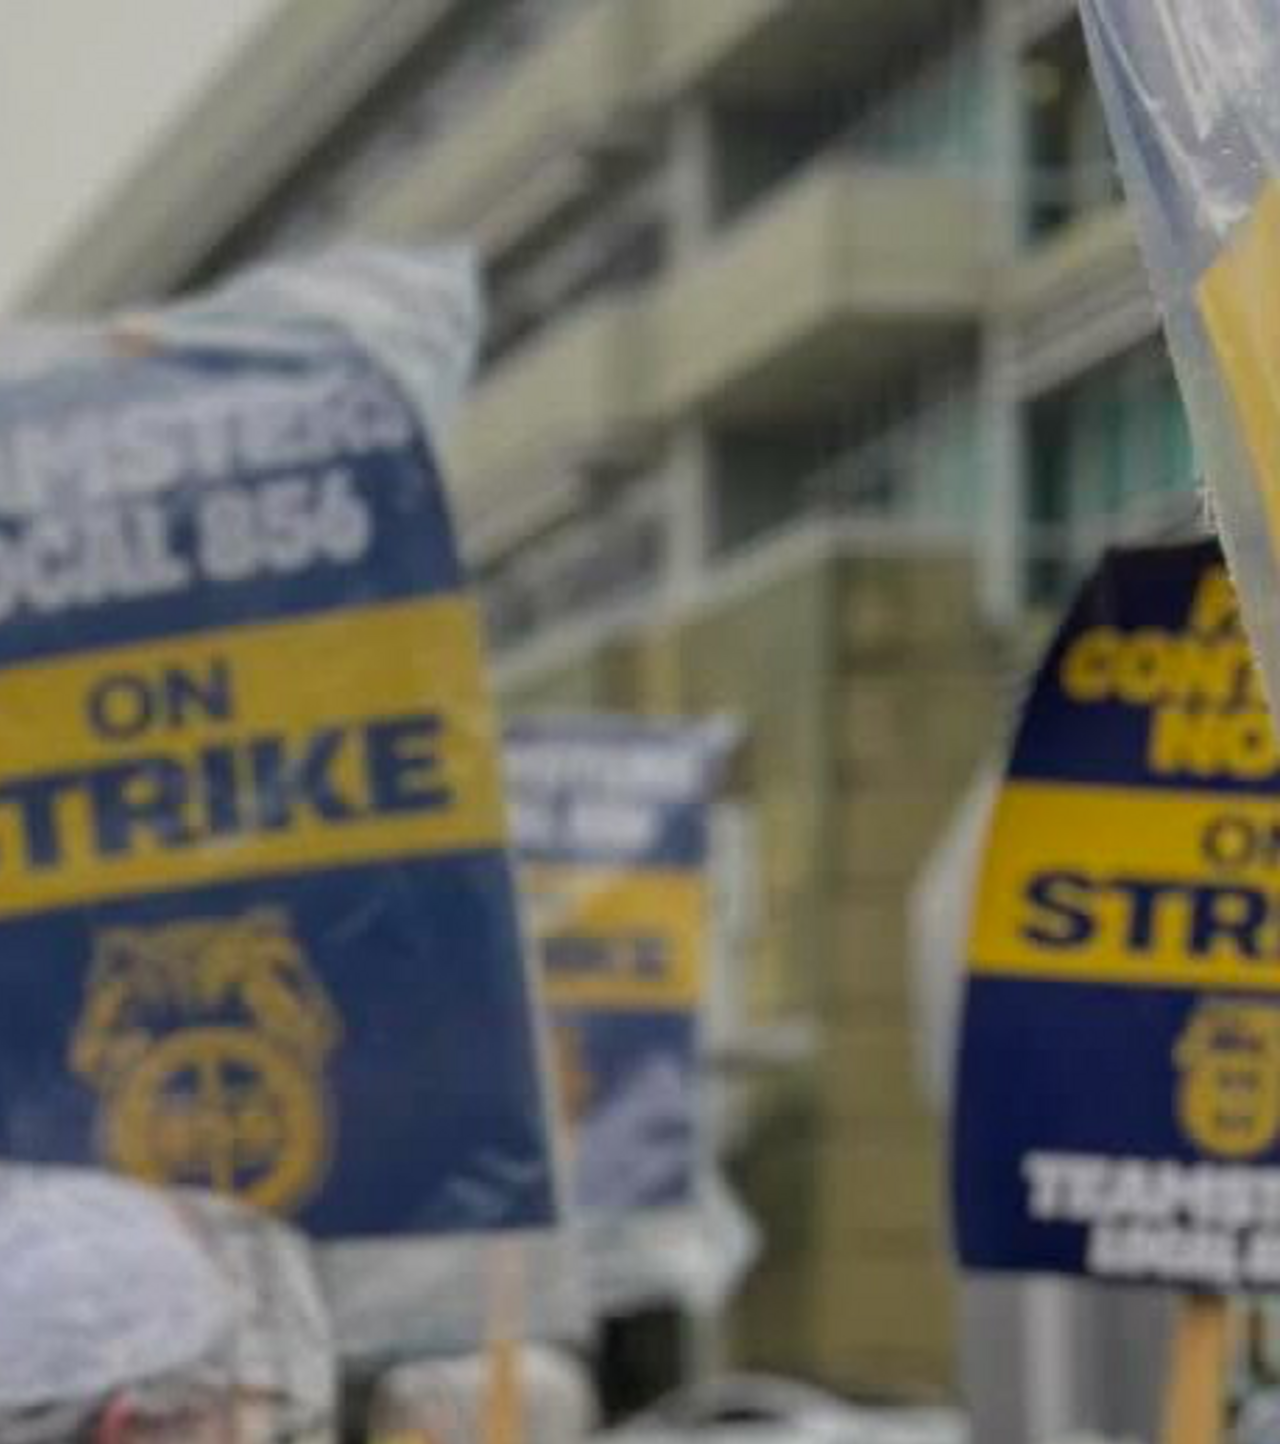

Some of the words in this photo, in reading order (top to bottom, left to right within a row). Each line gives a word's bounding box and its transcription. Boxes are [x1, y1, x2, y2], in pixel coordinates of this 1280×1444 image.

[197, 467, 373, 580] 856
[87, 660, 231, 742] ON
[1201, 815, 1280, 874] O
